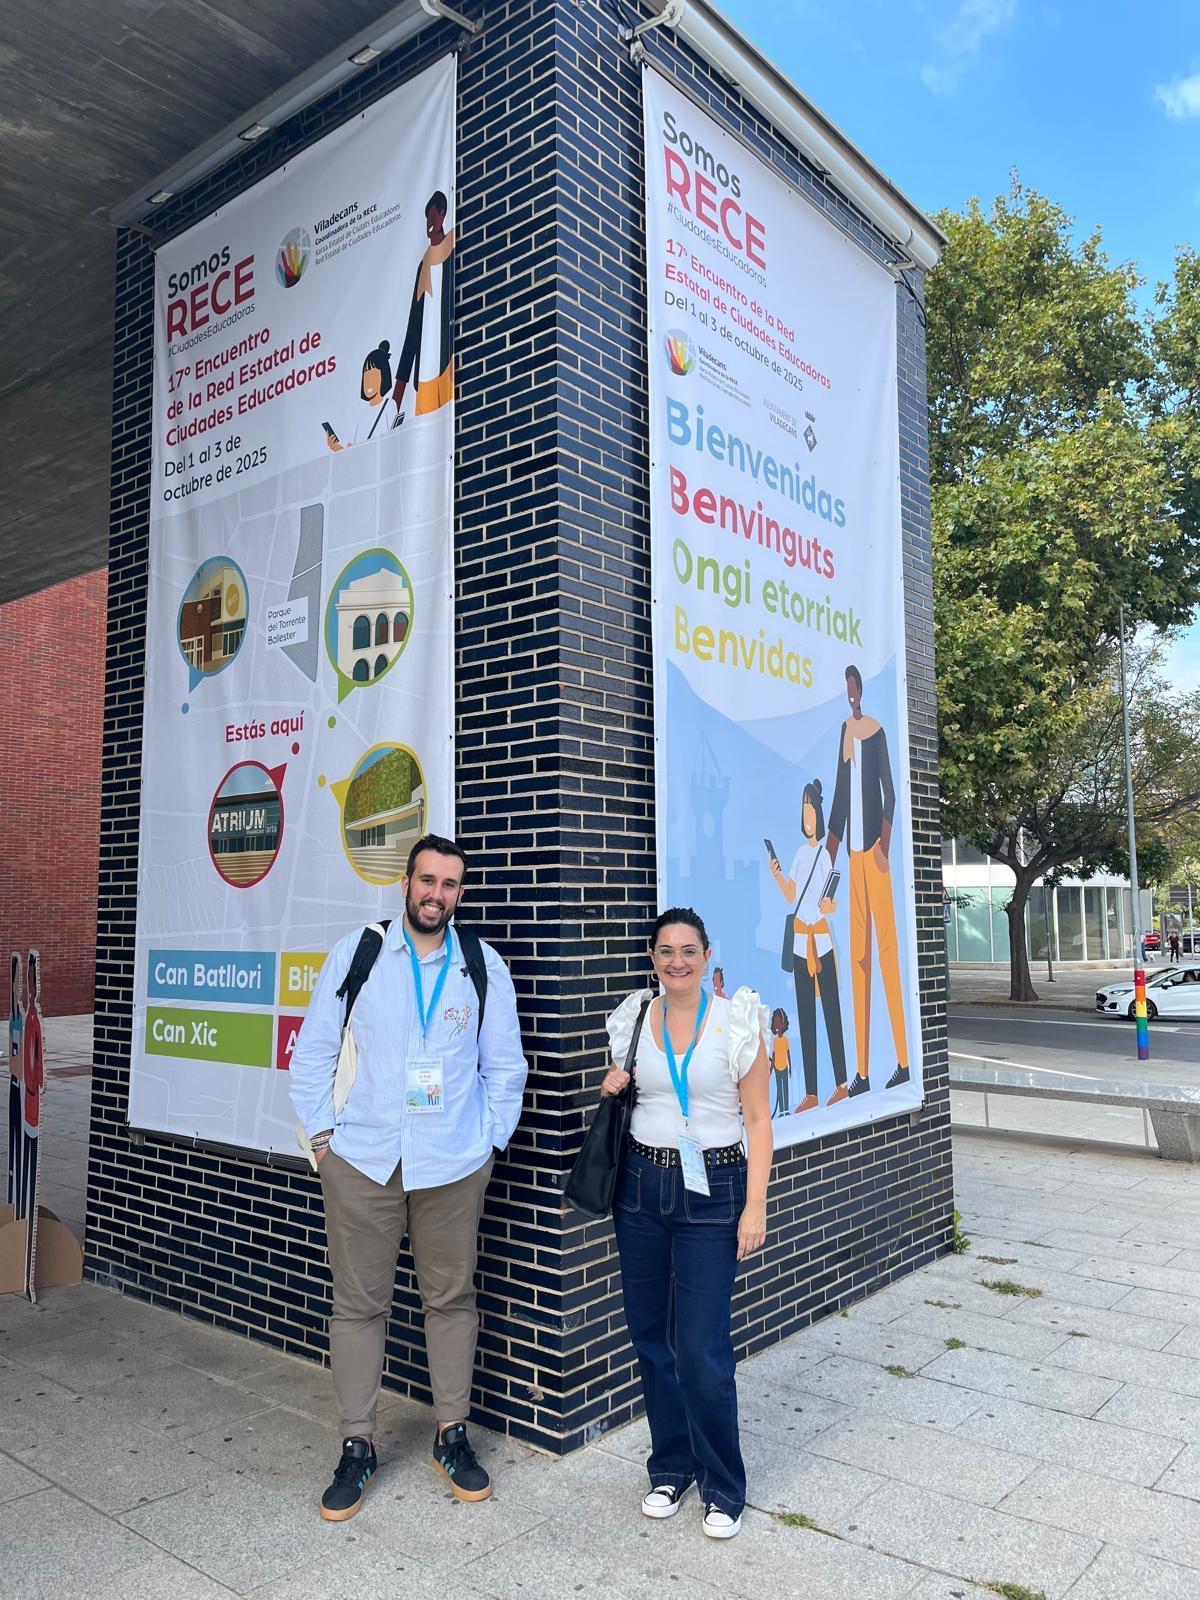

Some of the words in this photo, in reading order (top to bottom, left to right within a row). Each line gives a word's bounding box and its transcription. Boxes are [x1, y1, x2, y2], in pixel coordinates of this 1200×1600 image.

[662, 111, 741, 198] Somos
[314, 201, 358, 234] Viladecans
[315, 222, 348, 245] Coordinadora
[349, 217, 356, 225] de
[363, 203, 377, 217] RECE
[329, 234, 344, 248] Estatal
[345, 230, 351, 238] de
[371, 203, 400, 223] Educadores
[663, 144, 767, 271] RECE
[315, 255, 324, 265] Red
[325, 246, 340, 260] Estatal
[341, 242, 347, 251] de
[348, 230, 371, 247] Ciudades
[373, 214, 401, 234] Educadoras
[667, 202, 767, 288] #CiudadesEducadoras
[167, 254, 255, 344] RECE
[168, 245, 231, 299] Somos
[665, 263, 710, 303] Estatal
[713, 296, 727, 314] de
[731, 307, 776, 350] Ciudades
[778, 341, 831, 389] Educadoras
[691, 255, 747, 306] Encuentro
[751, 300, 762, 318] de
[765, 309, 774, 326] la
[777, 318, 795, 344] Red
[168, 303, 256, 357] #CiudadesEducadoras
[195, 328, 270, 379] Encuentro
[664, 290, 688, 311] Del
[691, 302, 696, 317] 1
[699, 311, 708, 326] al
[711, 316, 717, 332] 3
[720, 325, 733, 342] de
[735, 336, 769, 367] octubre
[771, 361, 782, 376] de
[784, 368, 803, 391] 2025
[166, 405, 233, 446] Ciudades
[238, 356, 337, 415] Educadoras
[167, 400, 183, 420] de
[188, 392, 202, 410] la
[206, 372, 234, 401] Red
[239, 339, 295, 386] Estatal
[299, 332, 321, 354] de
[163, 473, 212, 501] octubre
[216, 465, 232, 482] de
[236, 446, 267, 474] 2025
[164, 458, 186, 477] Del
[188, 453, 195, 469] 1
[199, 446, 211, 463] al
[214, 441, 222, 458] 3
[225, 435, 241, 453] de
[666, 396, 846, 528] Bienvenidas
[669, 464, 835, 579] Benvinguts
[268, 607, 291, 618] Parque
[672, 538, 750, 608] Ongi
[762, 579, 863, 648] etorriak
[268, 622, 277, 632] del
[279, 616, 306, 629] Torrente
[268, 631, 296, 645] Ballester
[674, 604, 813, 688] Benvidas
[225, 719, 266, 743] Estás
[270, 710, 304, 736] aquí
[211, 808, 266, 833] ATRIUM
[154, 962, 187, 985] Can
[193, 963, 262, 989] Batllori
[152, 1018, 185, 1043] Can
[190, 1020, 217, 1047] Xic
